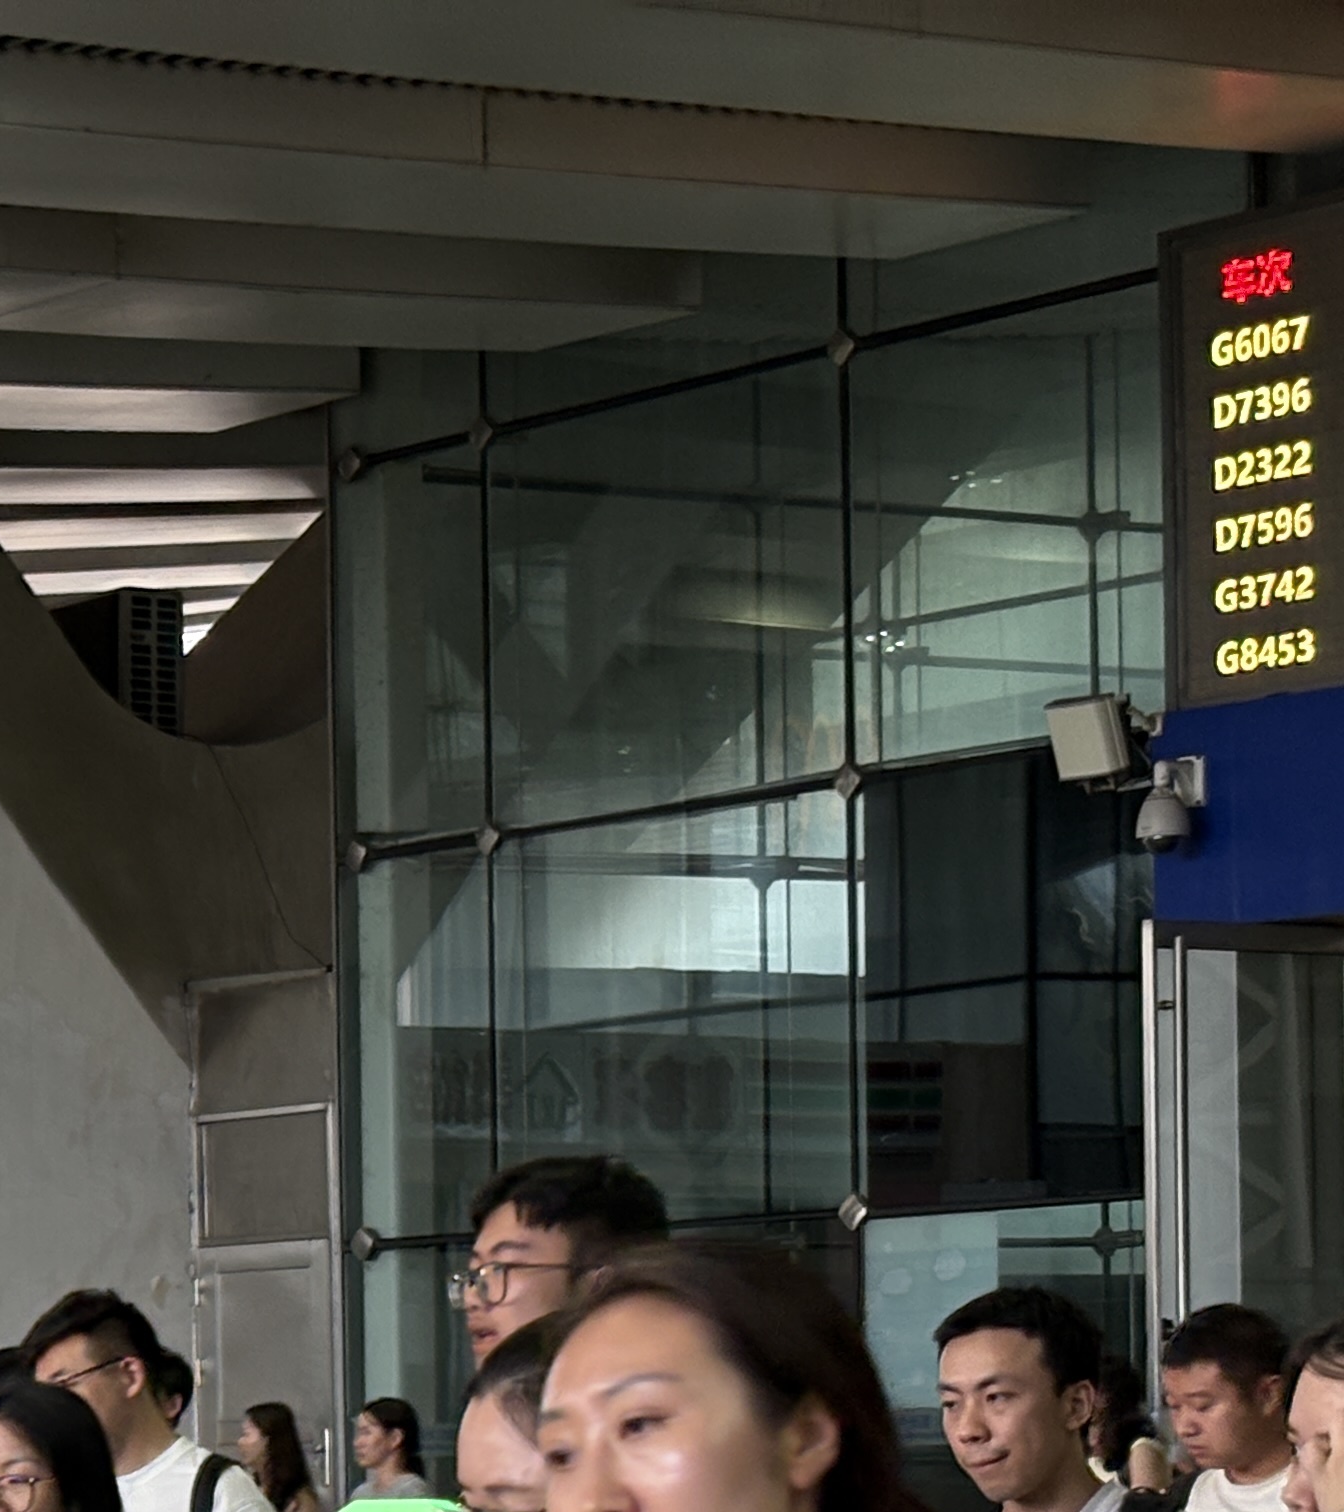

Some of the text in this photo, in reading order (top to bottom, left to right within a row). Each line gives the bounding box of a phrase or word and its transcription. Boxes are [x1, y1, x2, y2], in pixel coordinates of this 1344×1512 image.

[1221, 249, 1293, 303] 车次
[1212, 315, 1310, 366] G6067
[1213, 378, 1311, 429] D7396
[1214, 440, 1312, 491] D2322
[1216, 503, 1313, 553] D7596
[1216, 566, 1315, 614] G3742
[1216, 628, 1315, 675] G8453
